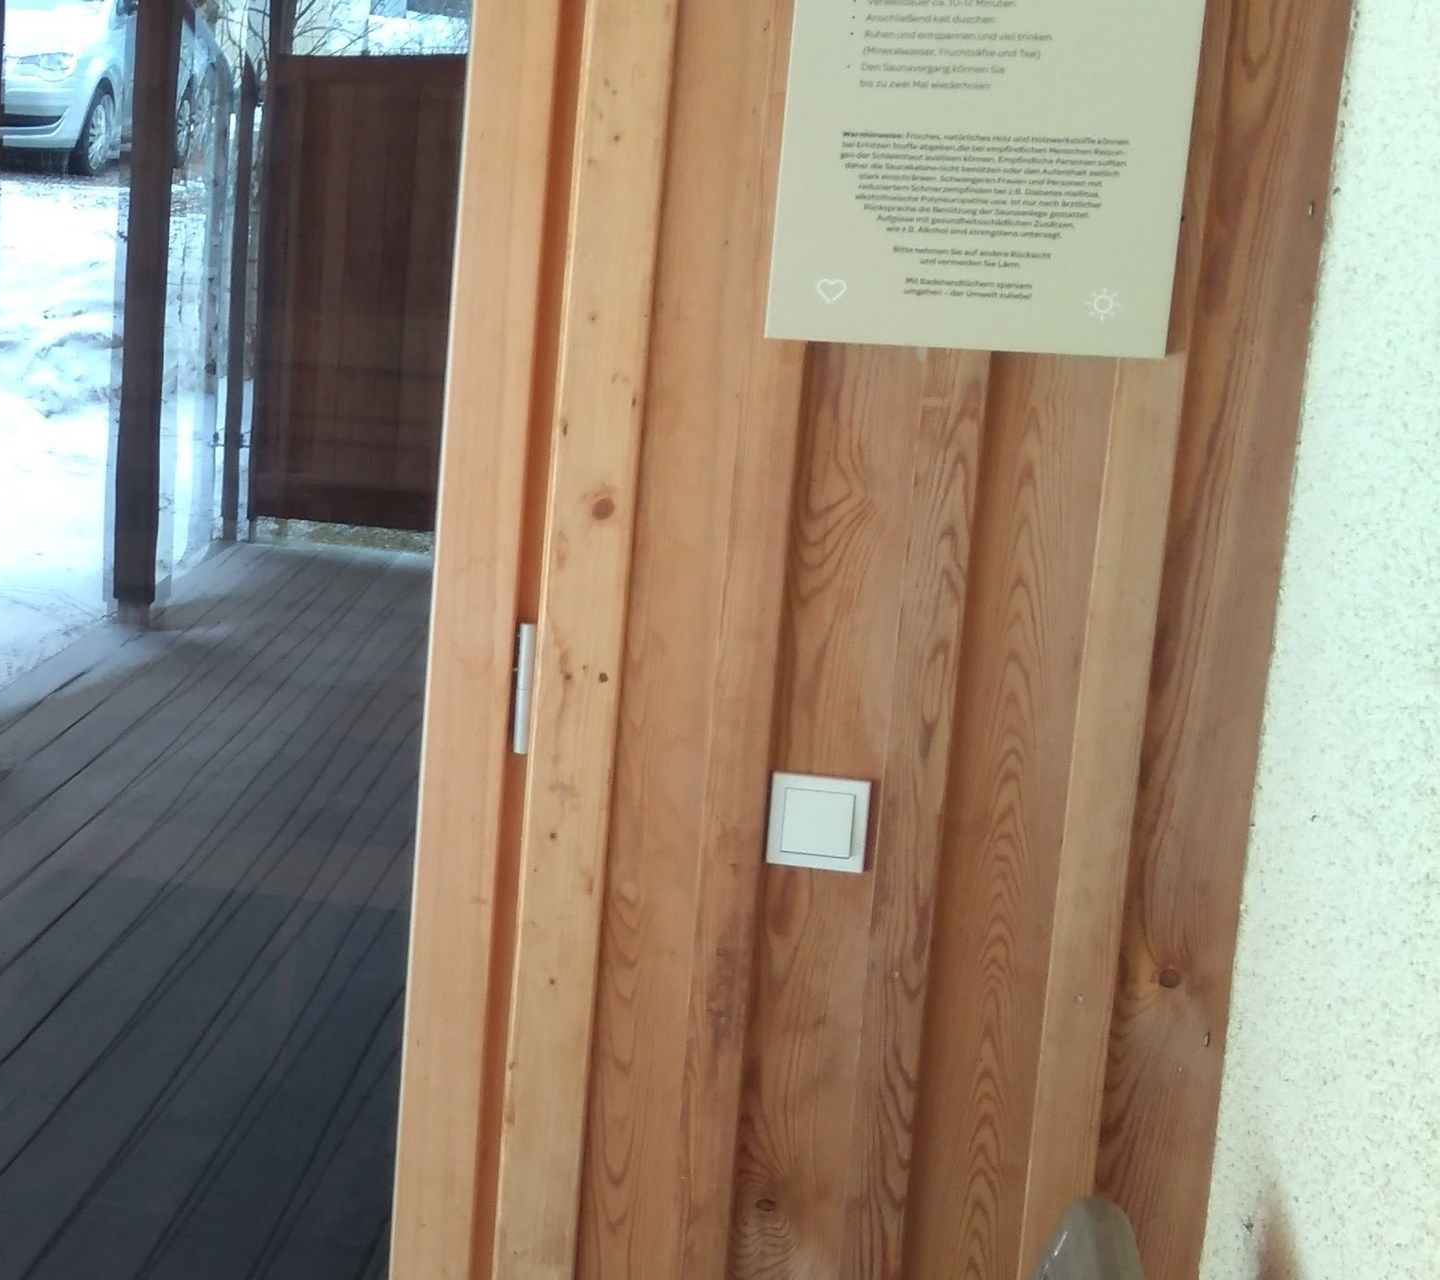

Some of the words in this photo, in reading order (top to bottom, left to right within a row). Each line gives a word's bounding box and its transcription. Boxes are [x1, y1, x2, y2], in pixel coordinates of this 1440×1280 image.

[975, 0, 1016, 8] Minuten
[951, 15, 995, 24] duschen
[897, 31, 915, 39] und
[977, 32, 997, 40] und
[1017, 33, 1052, 41] trinken
[997, 50, 1017, 58] und
[861, 64, 881, 72] Den
[990, 66, 1005, 74] Sie
